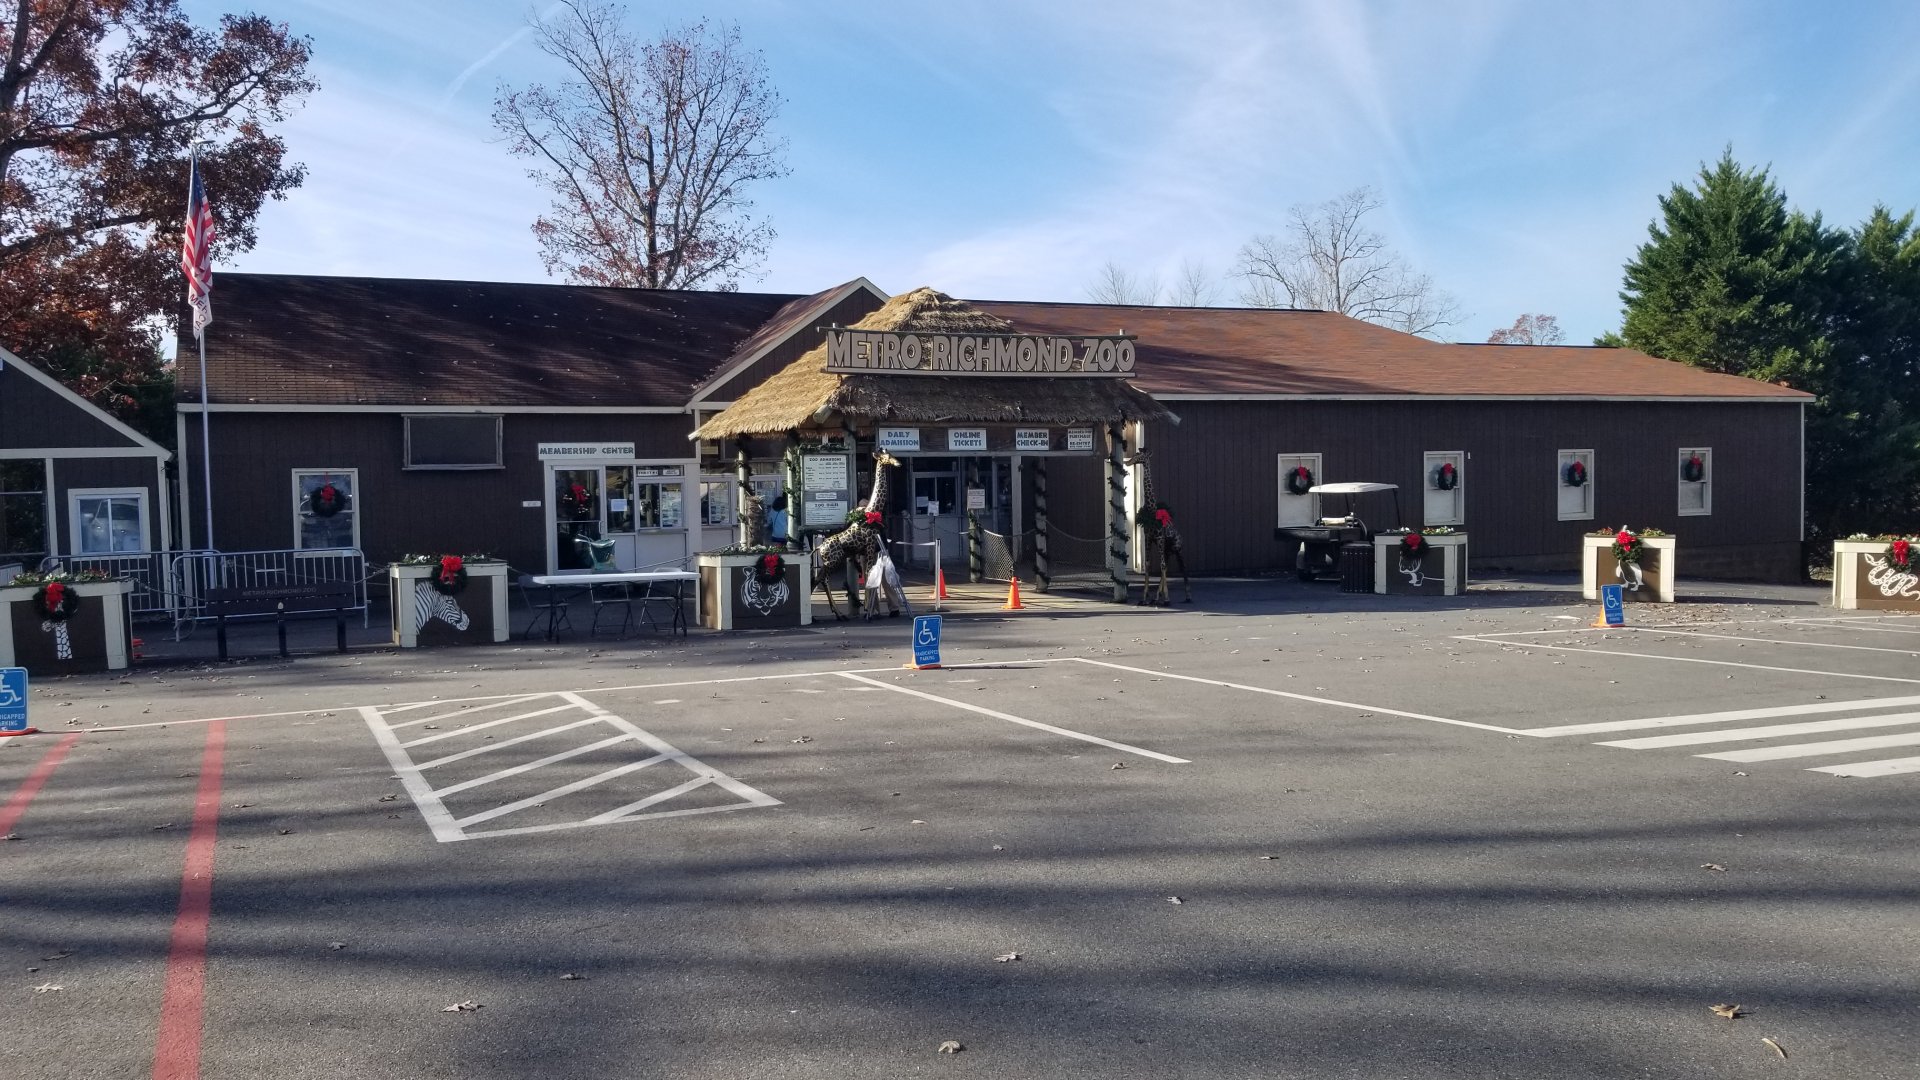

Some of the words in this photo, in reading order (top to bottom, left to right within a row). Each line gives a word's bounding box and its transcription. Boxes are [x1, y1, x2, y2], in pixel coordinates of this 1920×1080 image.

[827, 331, 922, 370] METRO
[932, 335, 1073, 372] RICHMOND
[1082, 338, 1136, 372] ZOO
[953, 431, 981, 439] ONLINE
[1016, 431, 1048, 439] MEMBER
[953, 439, 982, 447] TICKETS
[1016, 439, 1049, 447] CHECK-IN
[539, 447, 597, 455] MEMBERSHIP
[601, 446, 634, 454] CENTER
